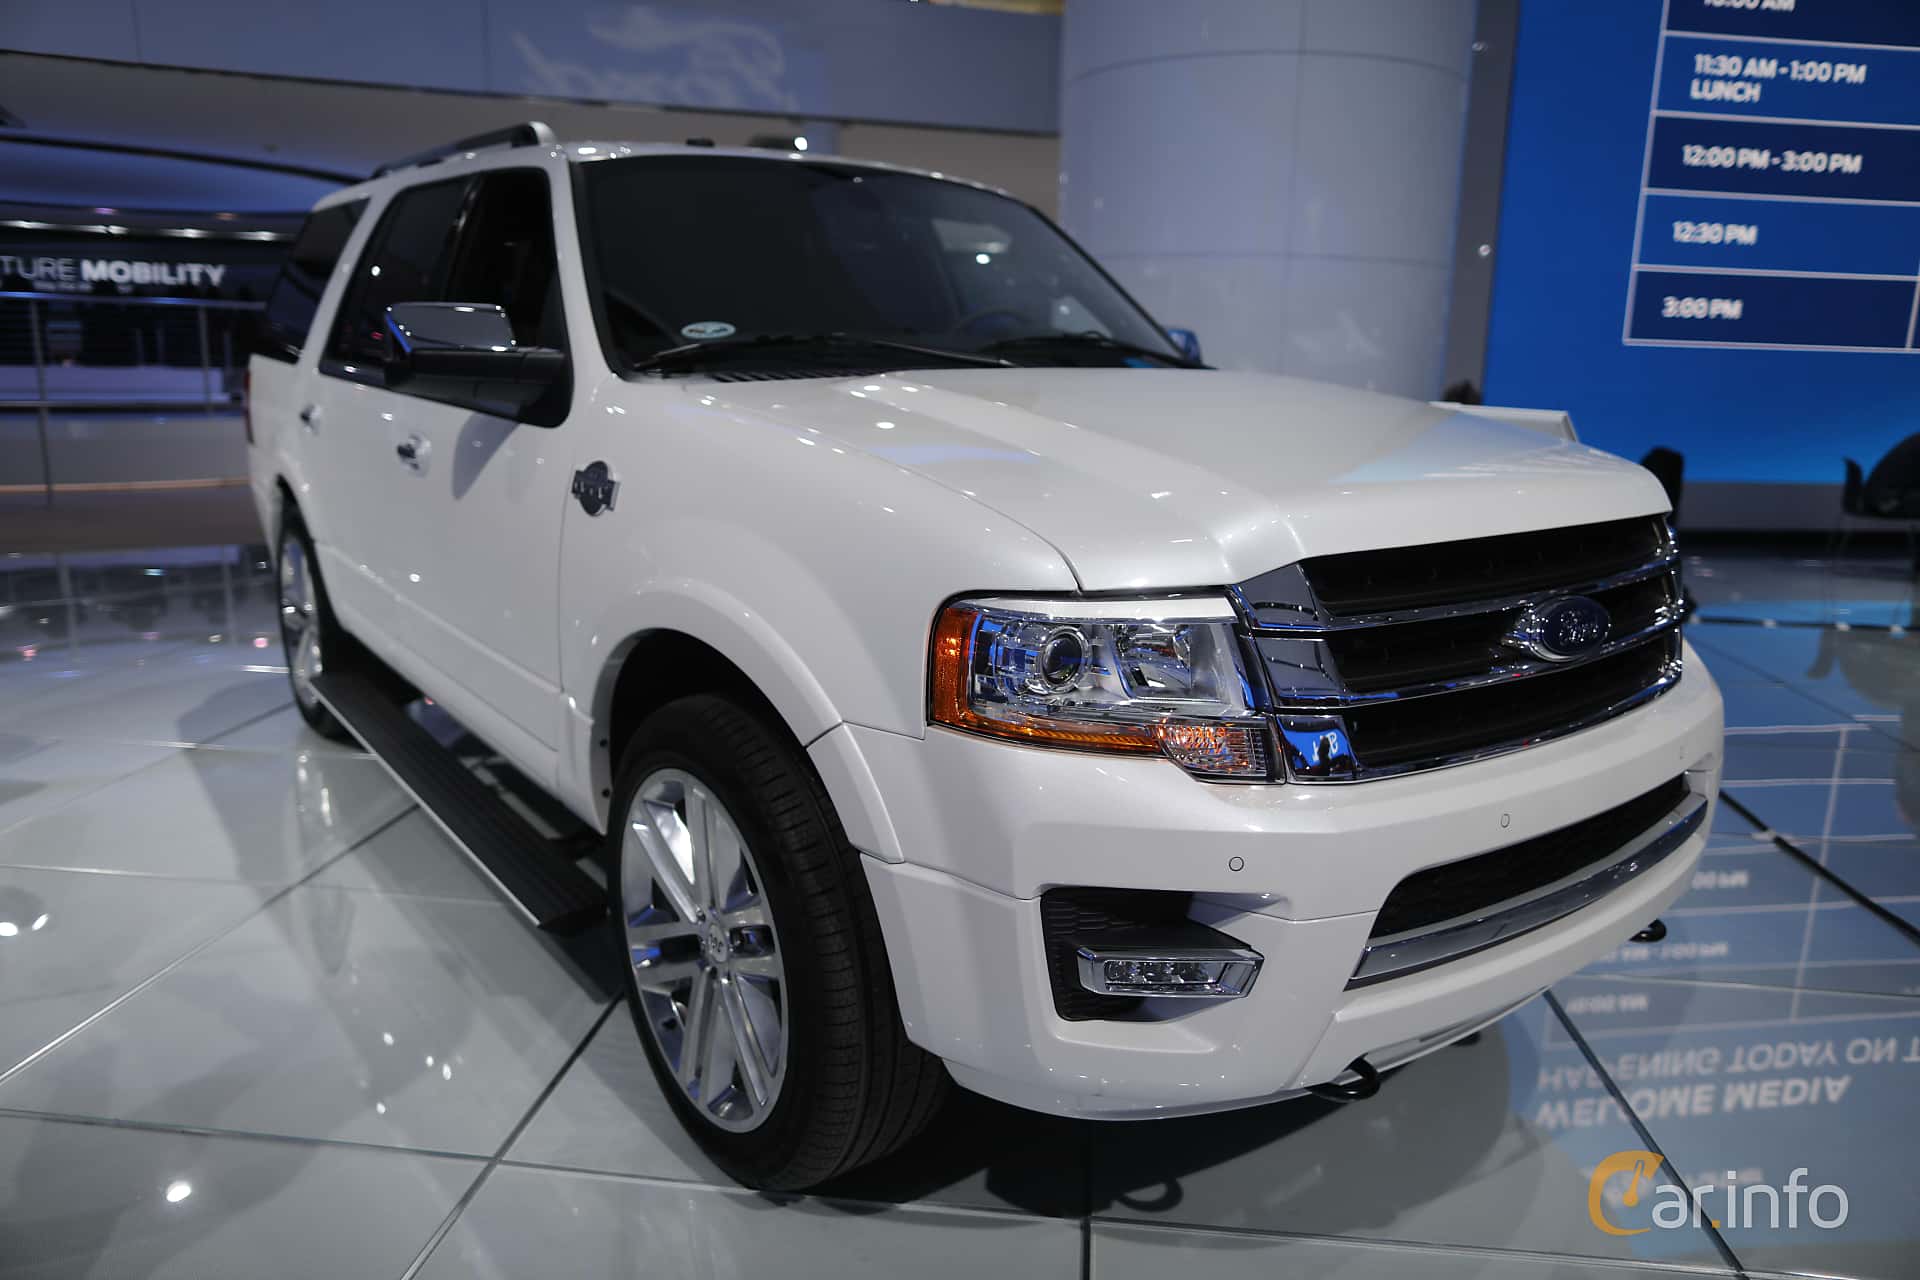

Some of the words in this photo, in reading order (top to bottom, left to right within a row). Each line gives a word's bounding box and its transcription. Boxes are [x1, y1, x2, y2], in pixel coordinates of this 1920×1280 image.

[1695, 54, 1742, 77] 11:30
[1743, 58, 1777, 79] AM
[1790, 60, 1832, 82] 1:00
[1833, 63, 1867, 84] PM
[1690, 78, 1761, 103] LUNCH
[1683, 144, 1735, 168] 12:00
[1737, 148, 1770, 169] PM
[1781, 150, 1828, 172] 3:00
[1829, 153, 1862, 174] PM
[1673, 220, 1723, 244] 12:30
[1724, 224, 1758, 245] PM
[0, 256, 74, 280] TURE
[81, 259, 225, 286] MOBILITY
[1662, 296, 1708, 319] 3:00
[1709, 299, 1743, 320] PM
